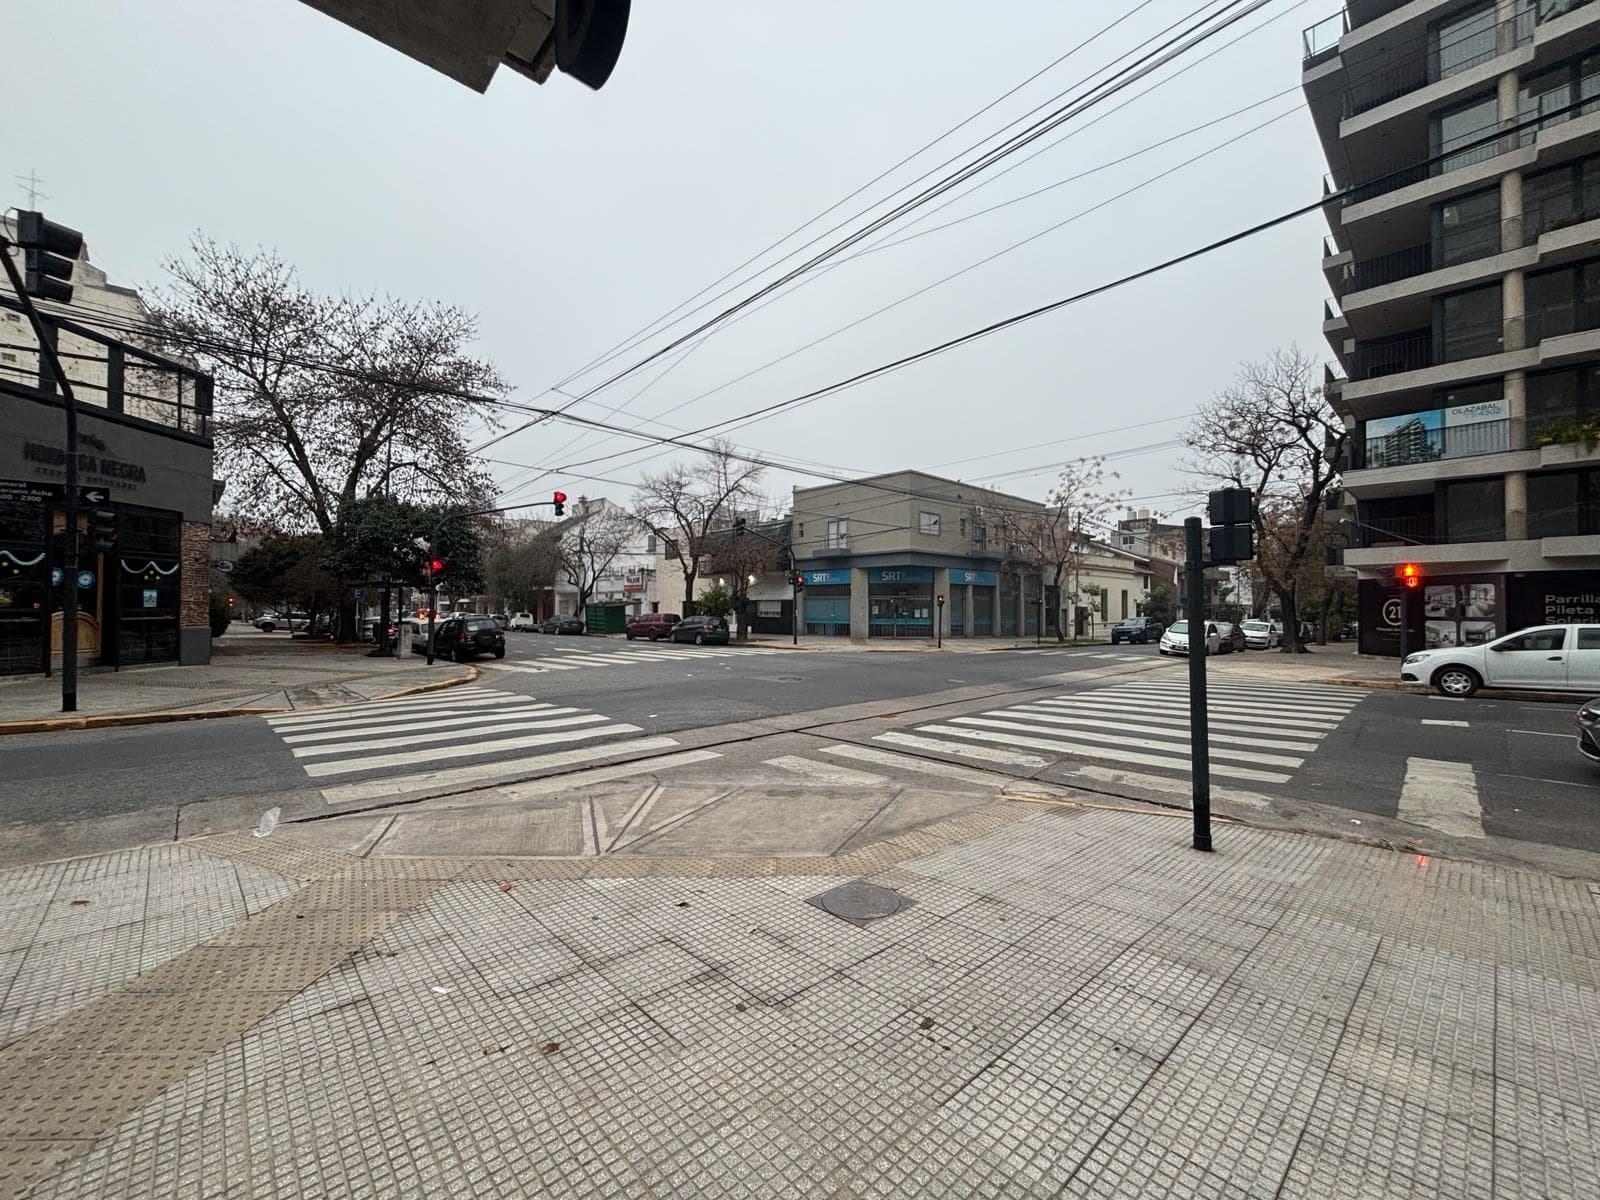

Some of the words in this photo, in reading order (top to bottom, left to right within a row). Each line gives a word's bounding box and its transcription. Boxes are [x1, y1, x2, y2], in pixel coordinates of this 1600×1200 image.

[812, 574, 827, 583] SRT
[881, 571, 901, 581] SRT
[964, 572, 976, 582] SRT
[1544, 605, 1595, 615] Pileta
